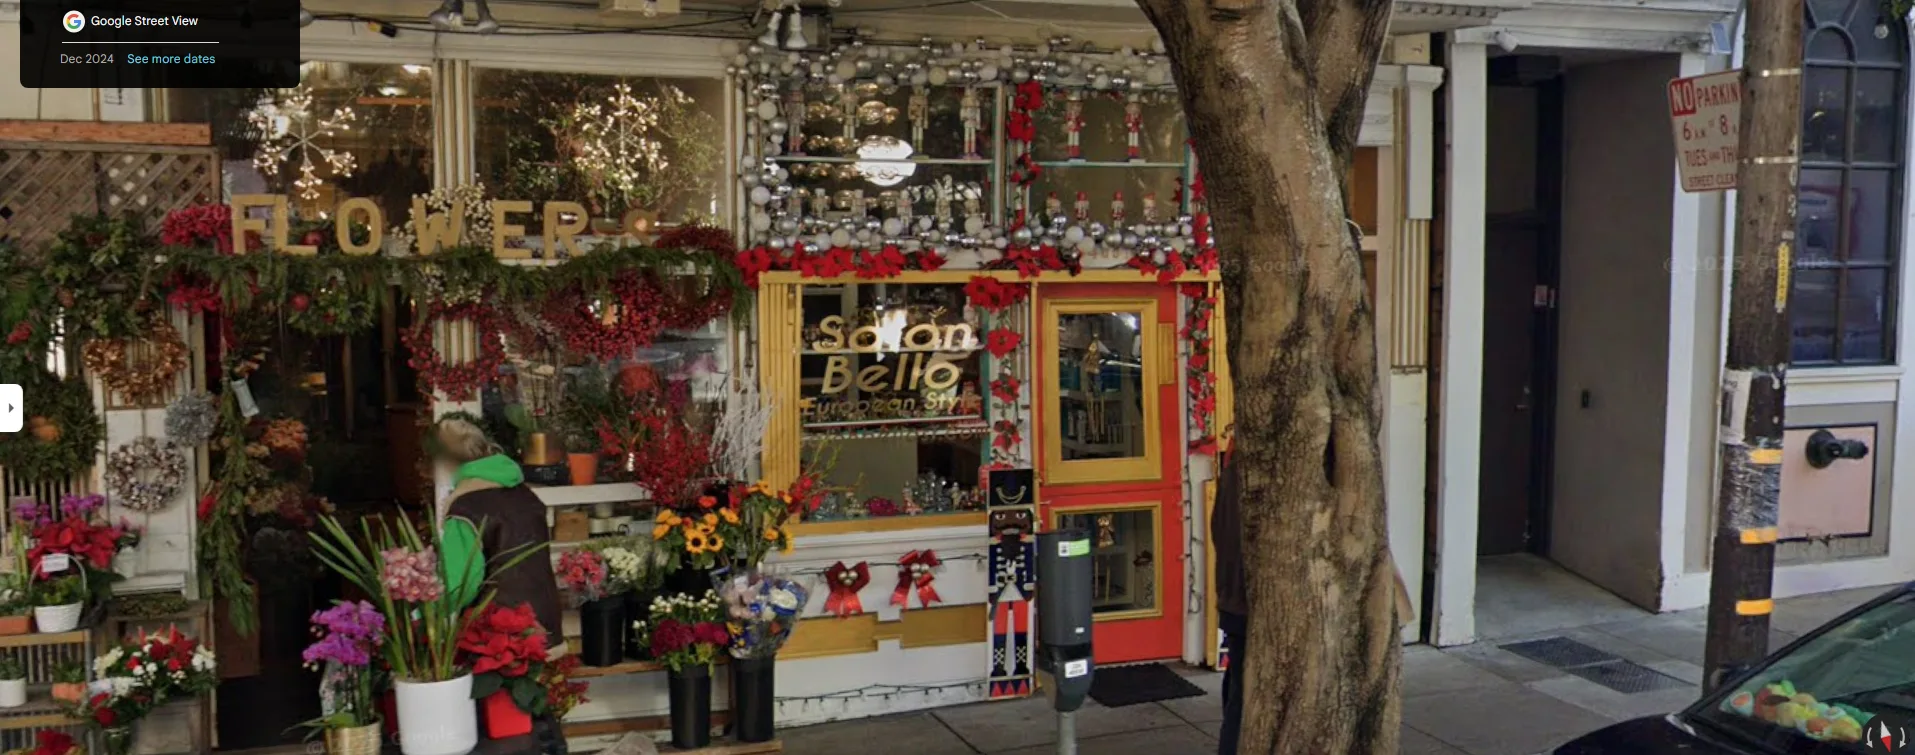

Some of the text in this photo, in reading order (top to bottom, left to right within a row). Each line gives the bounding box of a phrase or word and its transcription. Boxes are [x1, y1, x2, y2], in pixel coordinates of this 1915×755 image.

[1671, 82, 1740, 112] NO PARKIN
[1683, 121, 1692, 141] 6
[1720, 114, 1728, 135] 8
[1684, 149, 1708, 167] TUES
[1688, 173, 1738, 188] STREET CLEA
[821, 352, 962, 394] Bello
[802, 396, 916, 418] European
